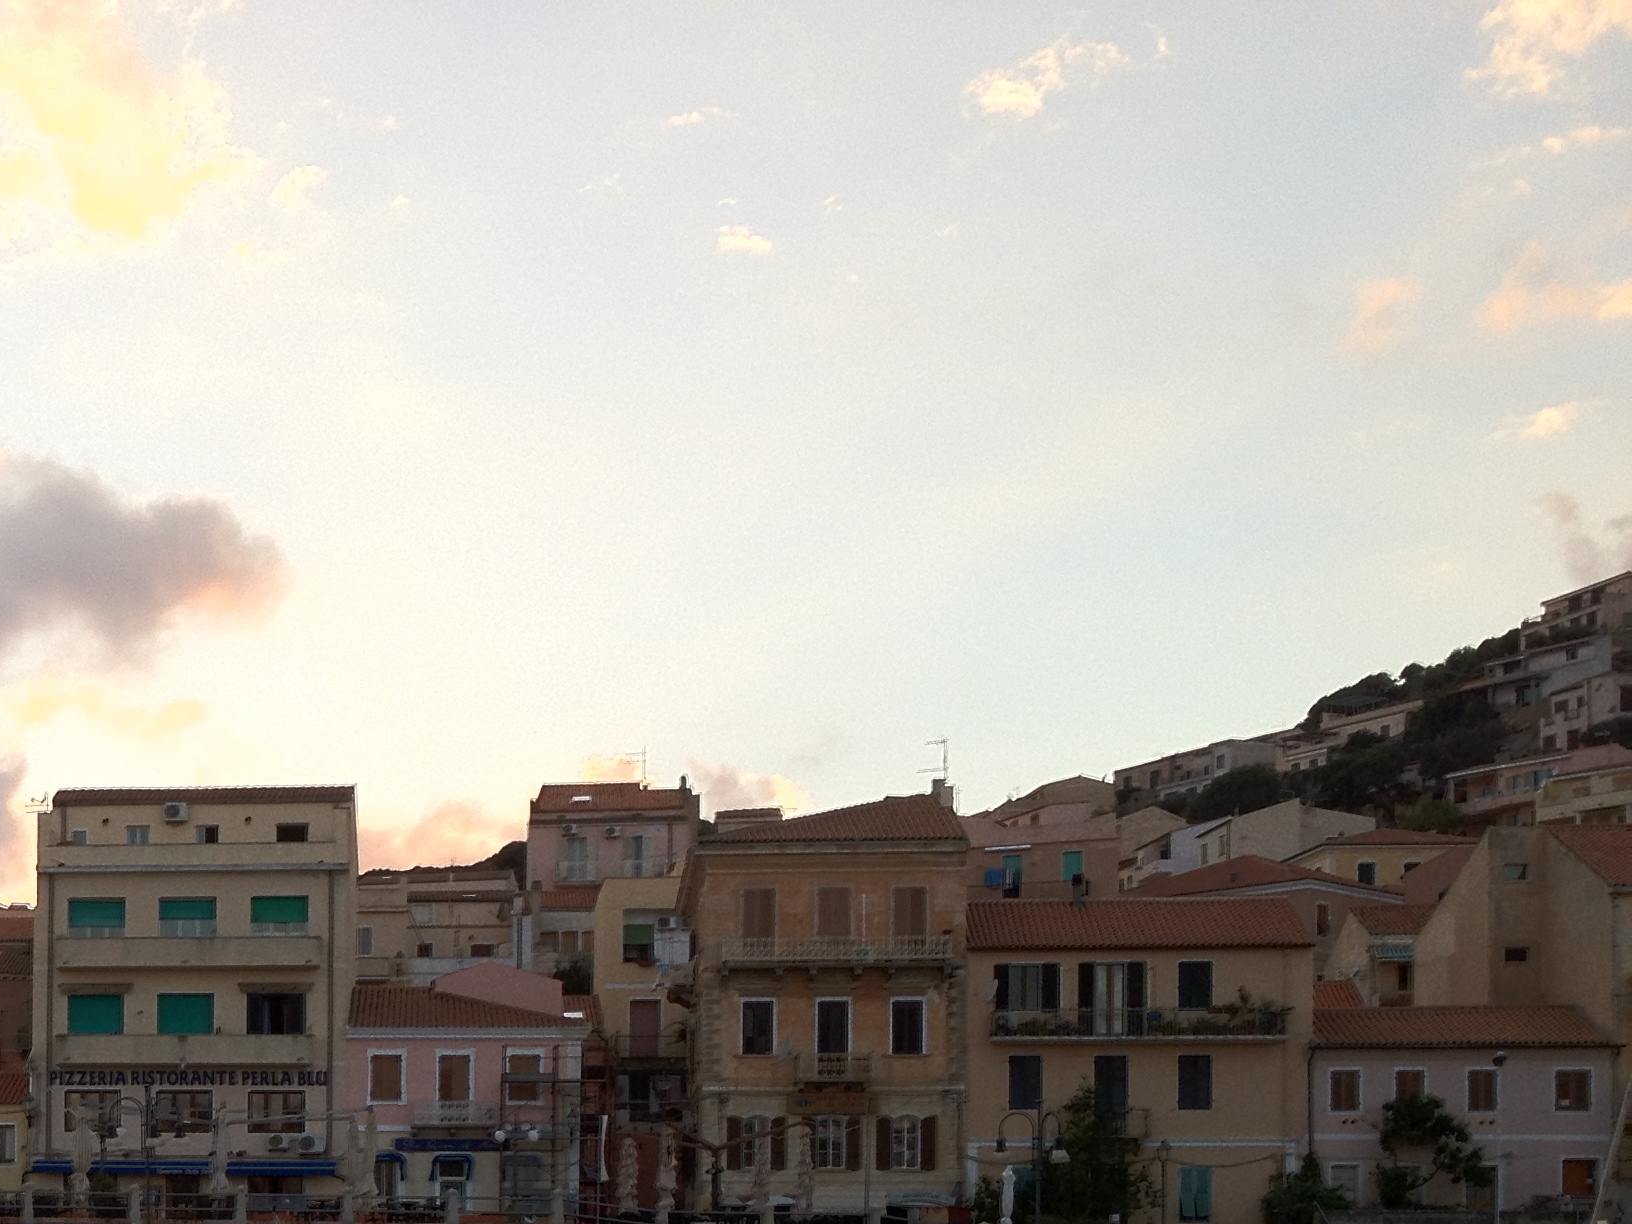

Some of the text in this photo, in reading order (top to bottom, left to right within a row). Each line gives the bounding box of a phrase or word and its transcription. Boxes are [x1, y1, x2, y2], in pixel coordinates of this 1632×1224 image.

[48, 1070, 328, 1086] PIZZERIA RISTORANTE PERLA BLU
